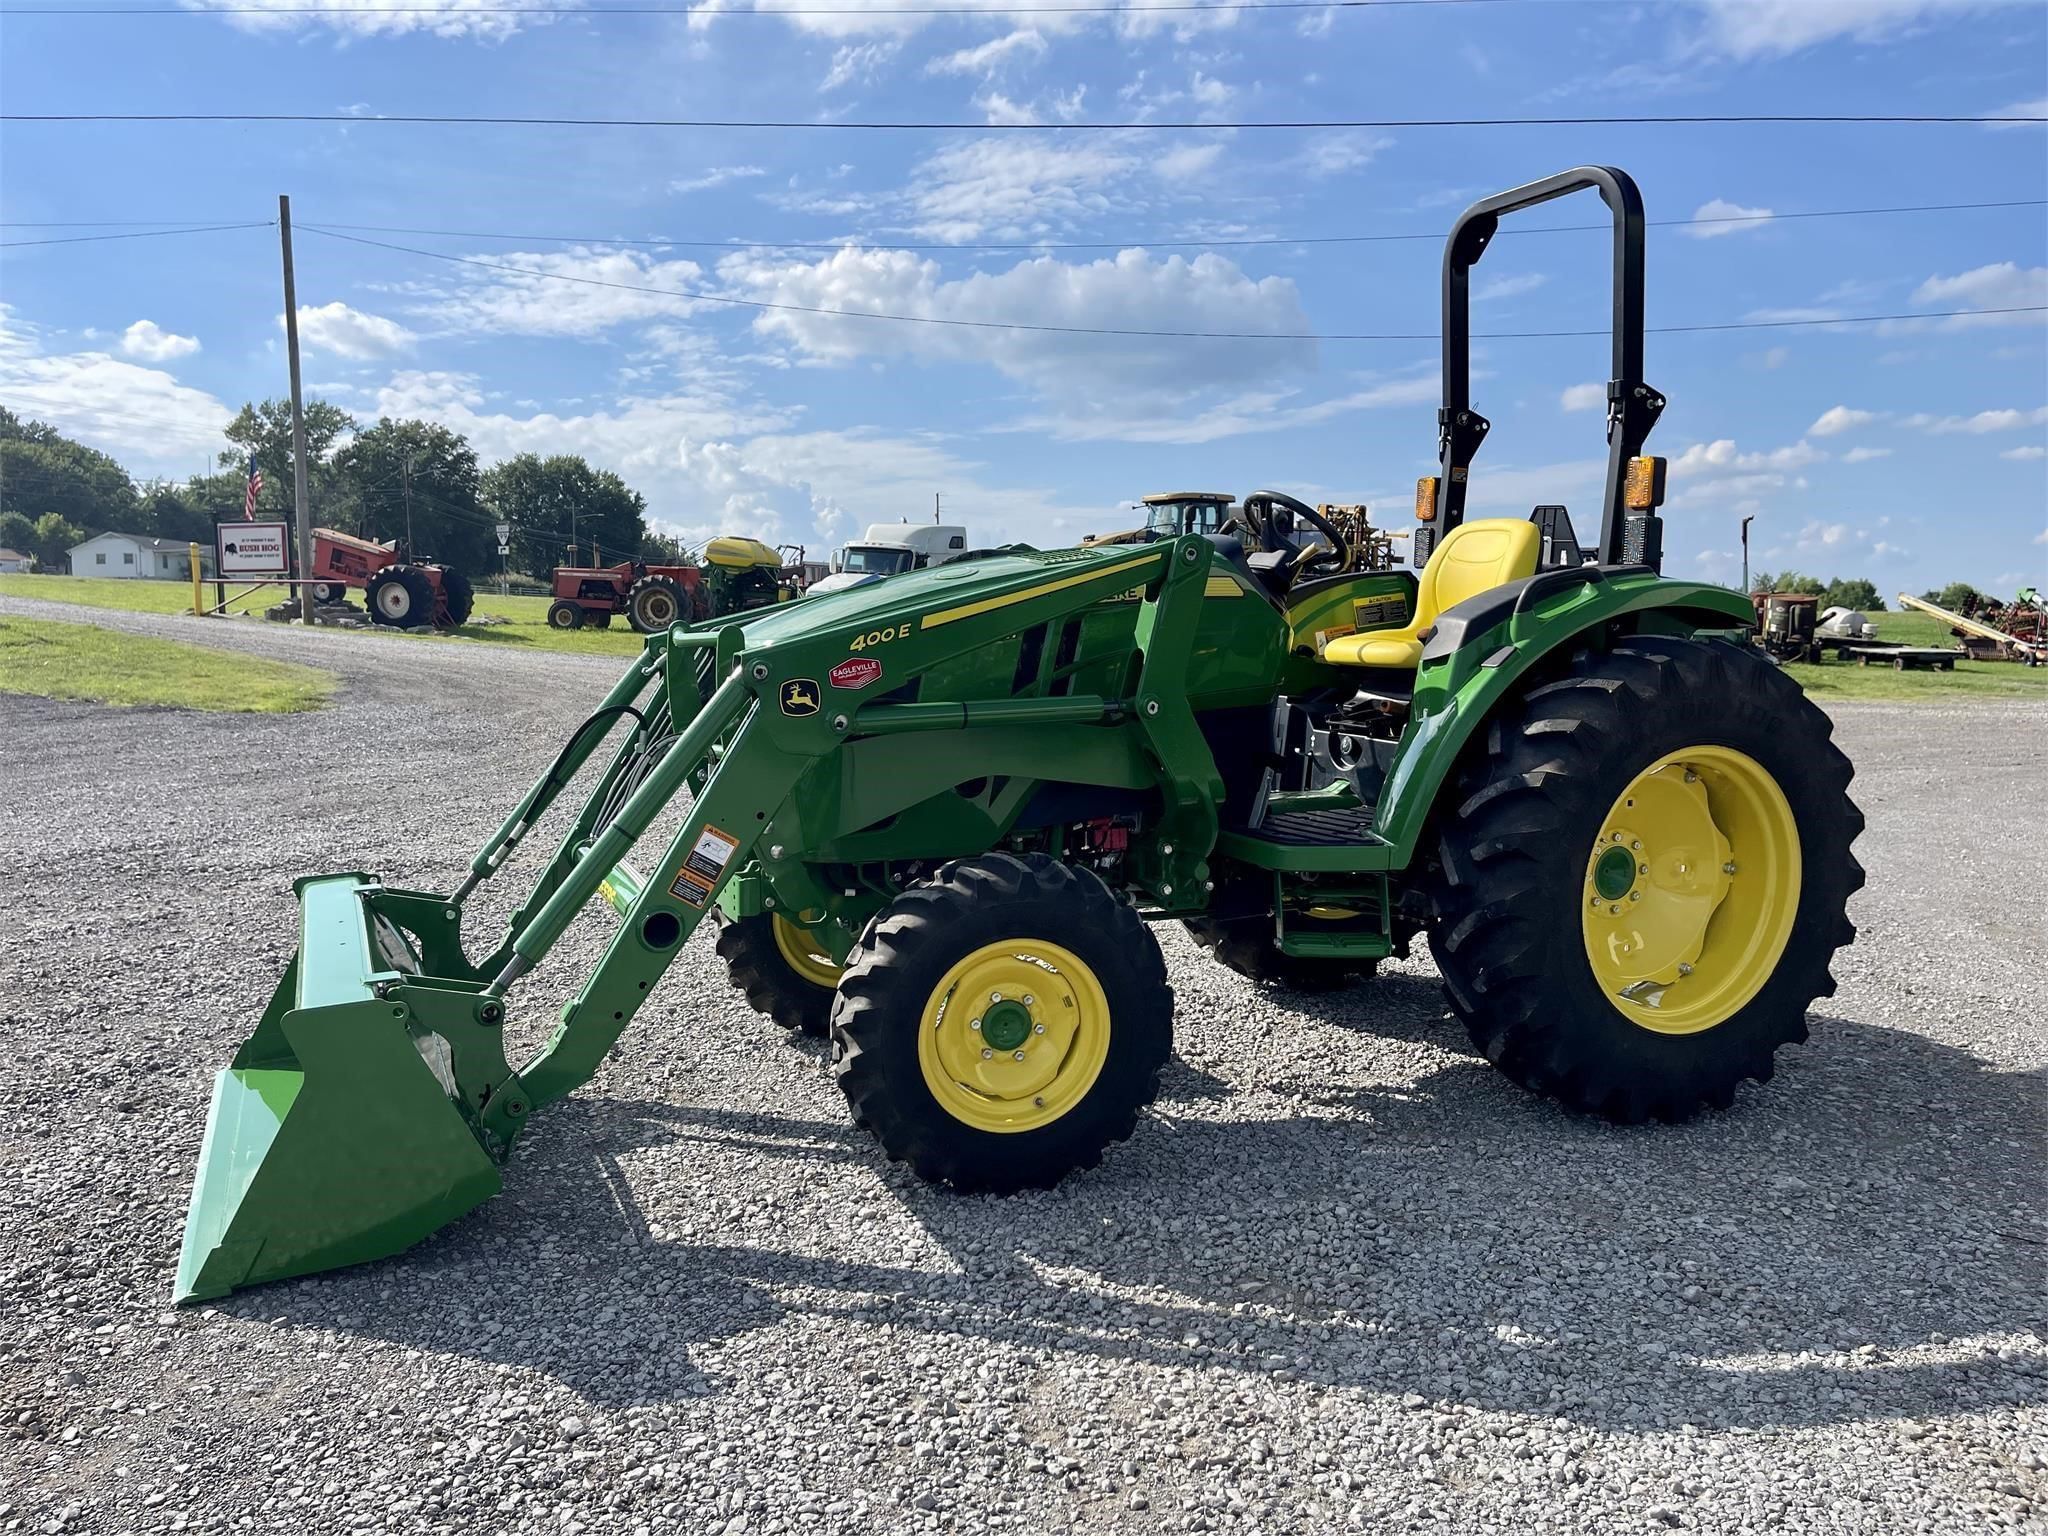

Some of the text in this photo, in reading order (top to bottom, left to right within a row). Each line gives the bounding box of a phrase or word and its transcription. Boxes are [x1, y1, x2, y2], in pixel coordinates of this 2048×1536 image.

[239, 543, 280, 552] BUSH HOG
[849, 623, 912, 652] 400 E
[832, 661, 878, 677] EAGLEVILLE
